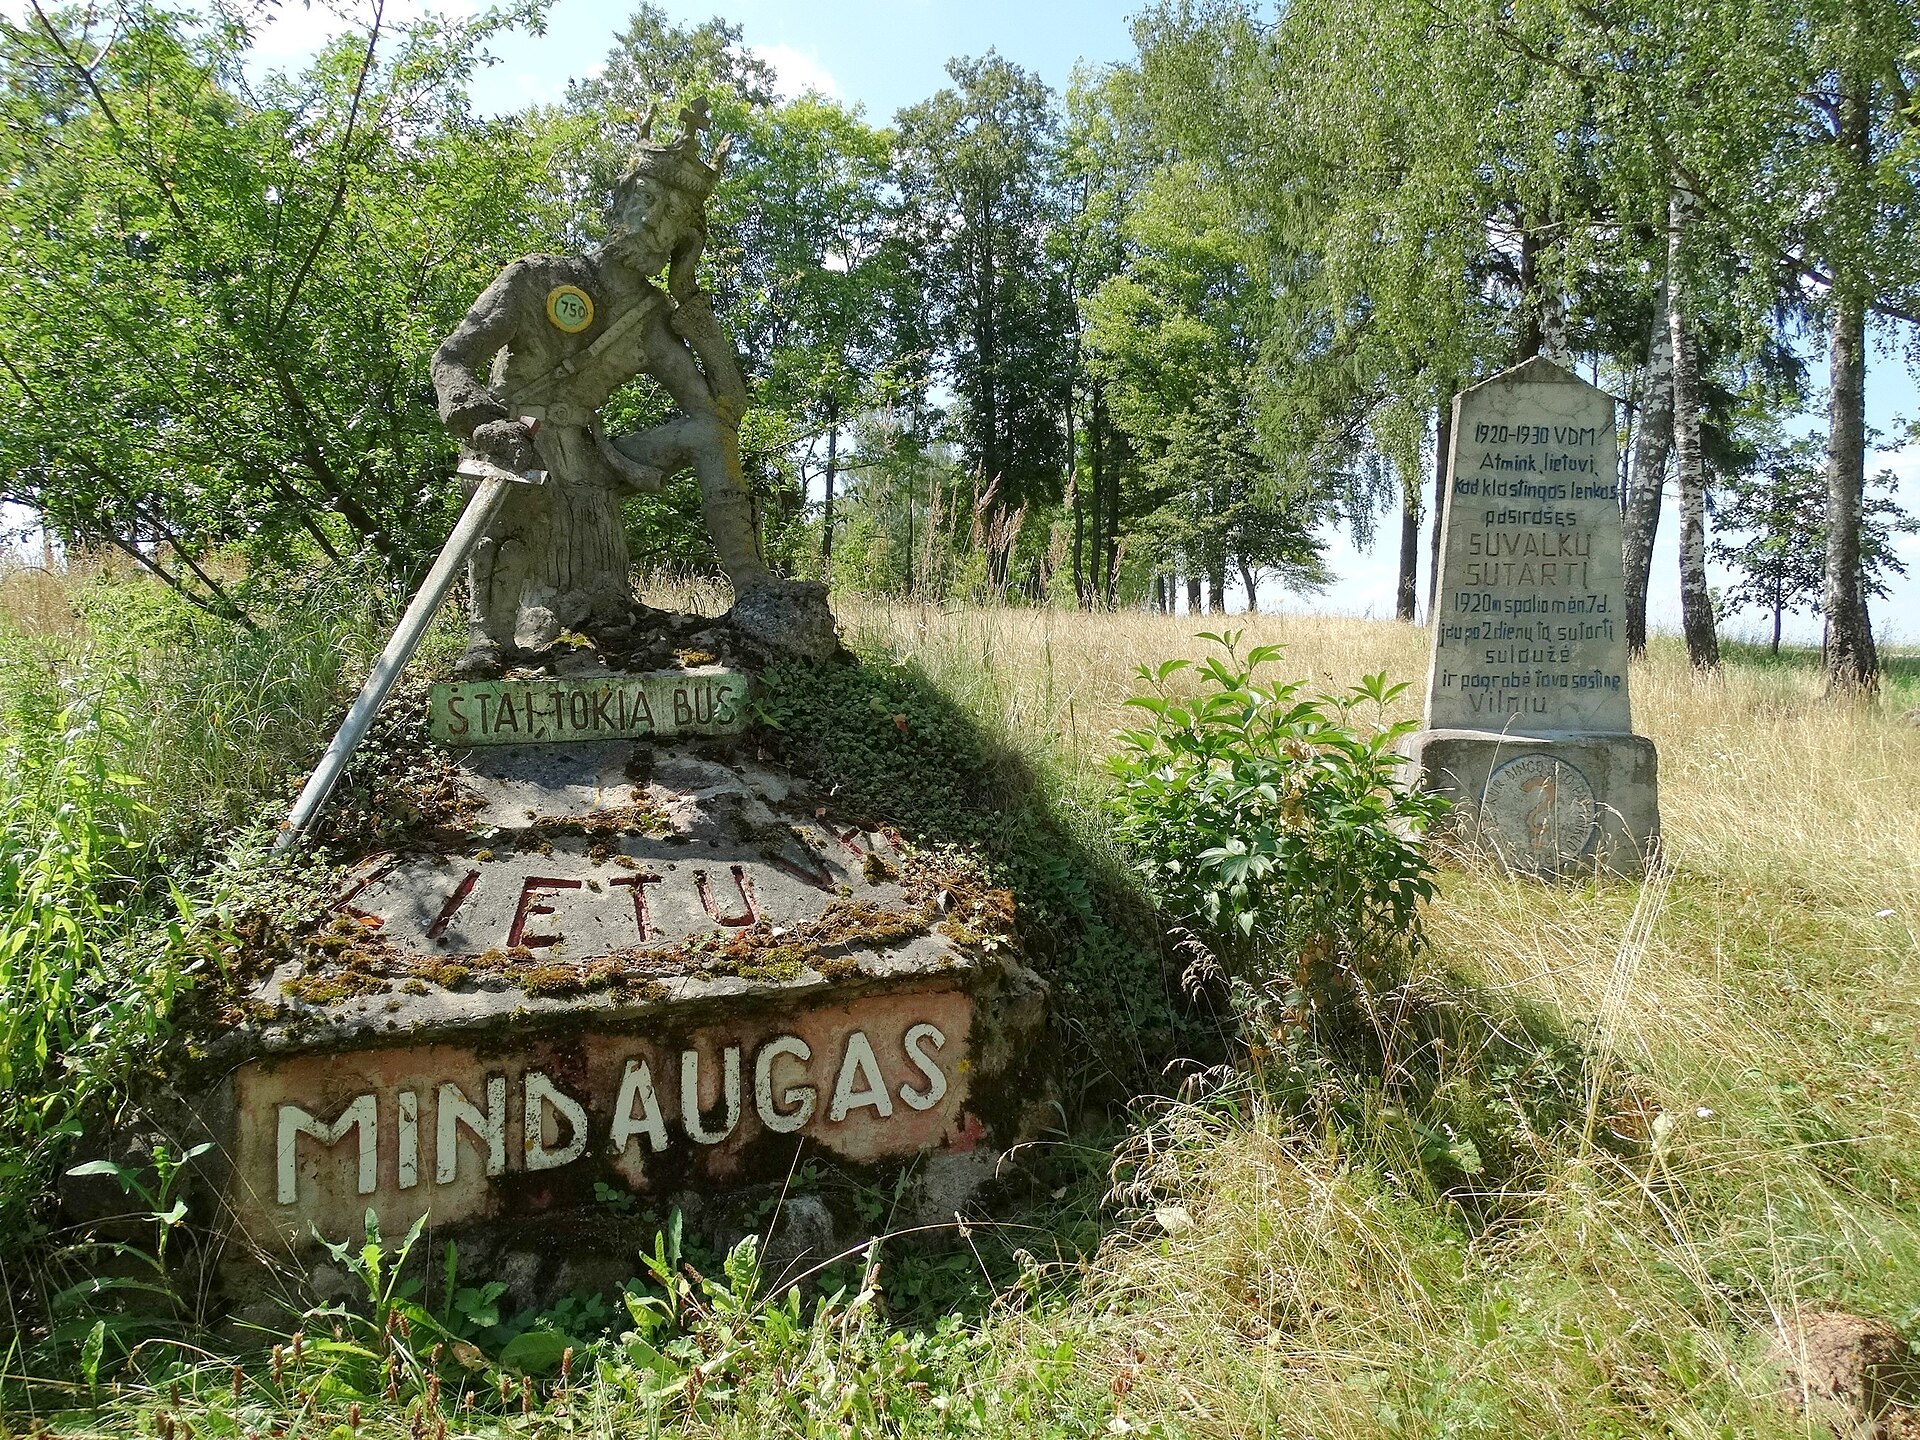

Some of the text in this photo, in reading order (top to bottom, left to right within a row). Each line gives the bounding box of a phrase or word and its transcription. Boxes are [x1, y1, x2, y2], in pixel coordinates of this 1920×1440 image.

[560, 299, 586, 318] 750
[1474, 424, 1596, 446] 1920-1930 VDM
[1479, 452, 1599, 476] Atmink, lietuvi,
[1454, 476, 1618, 502] kad klastingas lenkas
[1469, 532, 1592, 559] SUVALKŲ
[1465, 562, 1589, 589] SUTARTĮ
[1504, 594, 1548, 619] spalio
[1440, 623, 1462, 647] jau
[1482, 621, 1491, 640] 2
[1494, 620, 1534, 642] dienų
[1536, 620, 1552, 642] tą
[1557, 618, 1614, 642] sutartį
[1485, 644, 1570, 663] sulaužė
[1442, 669, 1458, 687] ir
[1535, 669, 1568, 688] tavo
[550, 688, 656, 731] TOKIA
[673, 685, 737, 726] BUS
[275, 1022, 948, 1206] MINDAUGAS
